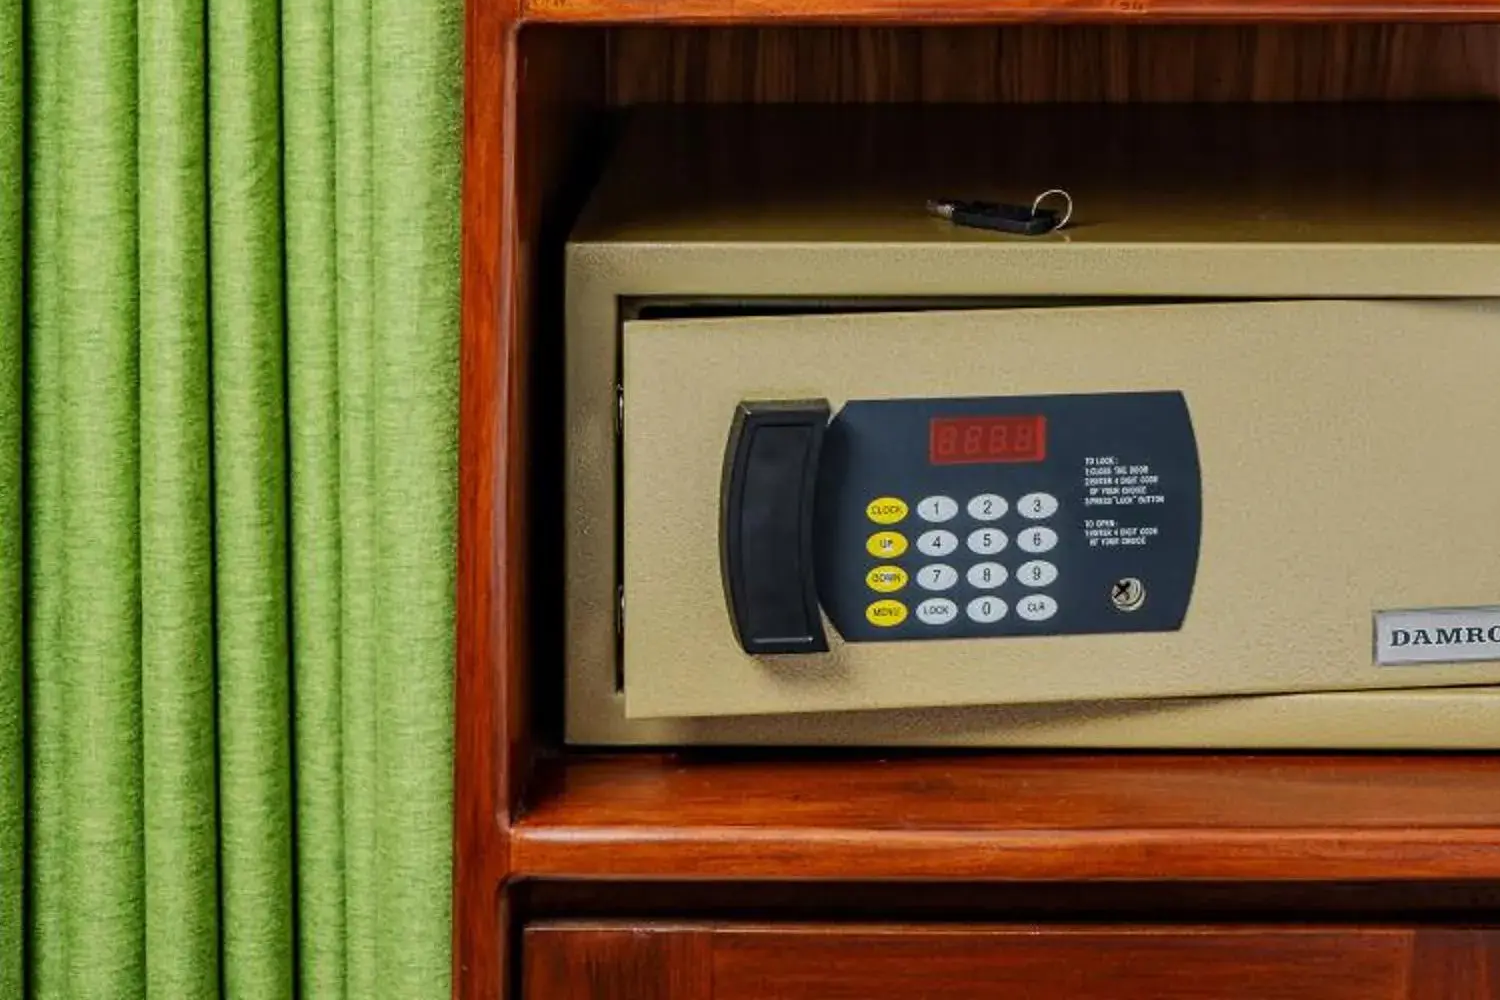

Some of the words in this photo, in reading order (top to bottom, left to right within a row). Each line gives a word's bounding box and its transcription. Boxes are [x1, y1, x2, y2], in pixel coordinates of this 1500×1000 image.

[871, 505, 902, 515] CLOCK
[933, 503, 940, 515] 1
[983, 499, 993, 515] 2
[1033, 498, 1042, 513] 3
[879, 539, 893, 549] UP
[932, 536, 941, 549] 4
[983, 533, 992, 547] 5
[1033, 532, 1041, 546] 6
[872, 573, 901, 583] DOWN
[932, 569, 941, 583] 7
[983, 567, 991, 581] 8
[1032, 566, 1041, 580] 9
[924, 606, 949, 616] LOCK
[983, 602, 991, 616] 0
